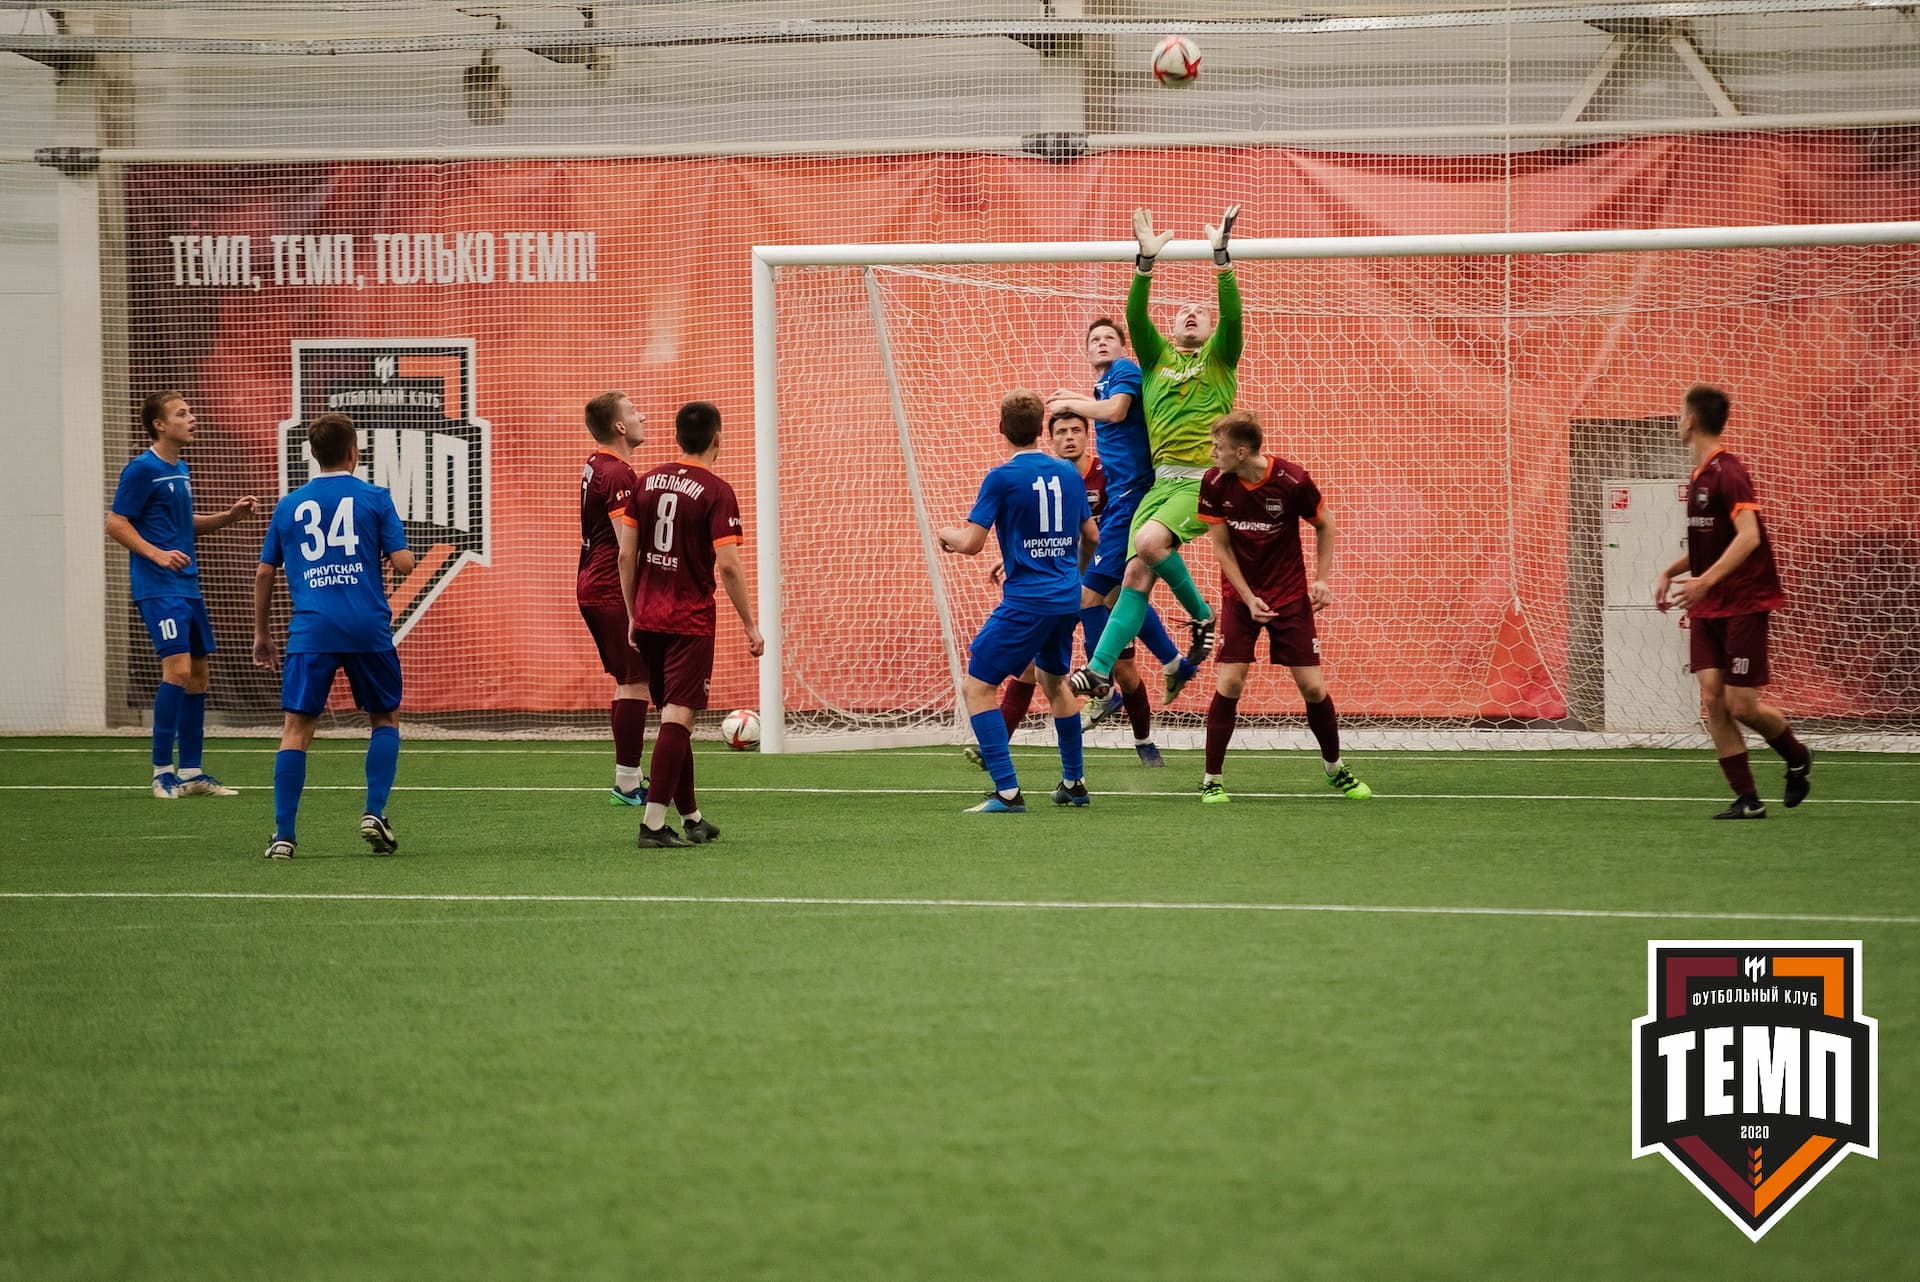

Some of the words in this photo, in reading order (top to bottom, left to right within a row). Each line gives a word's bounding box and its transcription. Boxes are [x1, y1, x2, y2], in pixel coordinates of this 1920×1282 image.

[169, 234, 261, 292] ТЕМП,
[270, 233, 364, 291] ТЕМП,
[373, 231, 495, 285] ТОЛЬКО
[503, 231, 597, 283] ТЕМП!
[645, 473, 705, 500] ЩЕБЛЫКИН
[1032, 475, 1063, 533] 11
[294, 496, 360, 562] 34
[653, 492, 678, 553] 8
[1023, 536, 1073, 549] ИРКУТСКАЯ
[303, 562, 364, 581] ИРКУТСКАЯ
[309, 574, 359, 589] ОБЛАСТЬ
[158, 618, 178, 641] 10
[1732, 657, 1749, 675] 30
